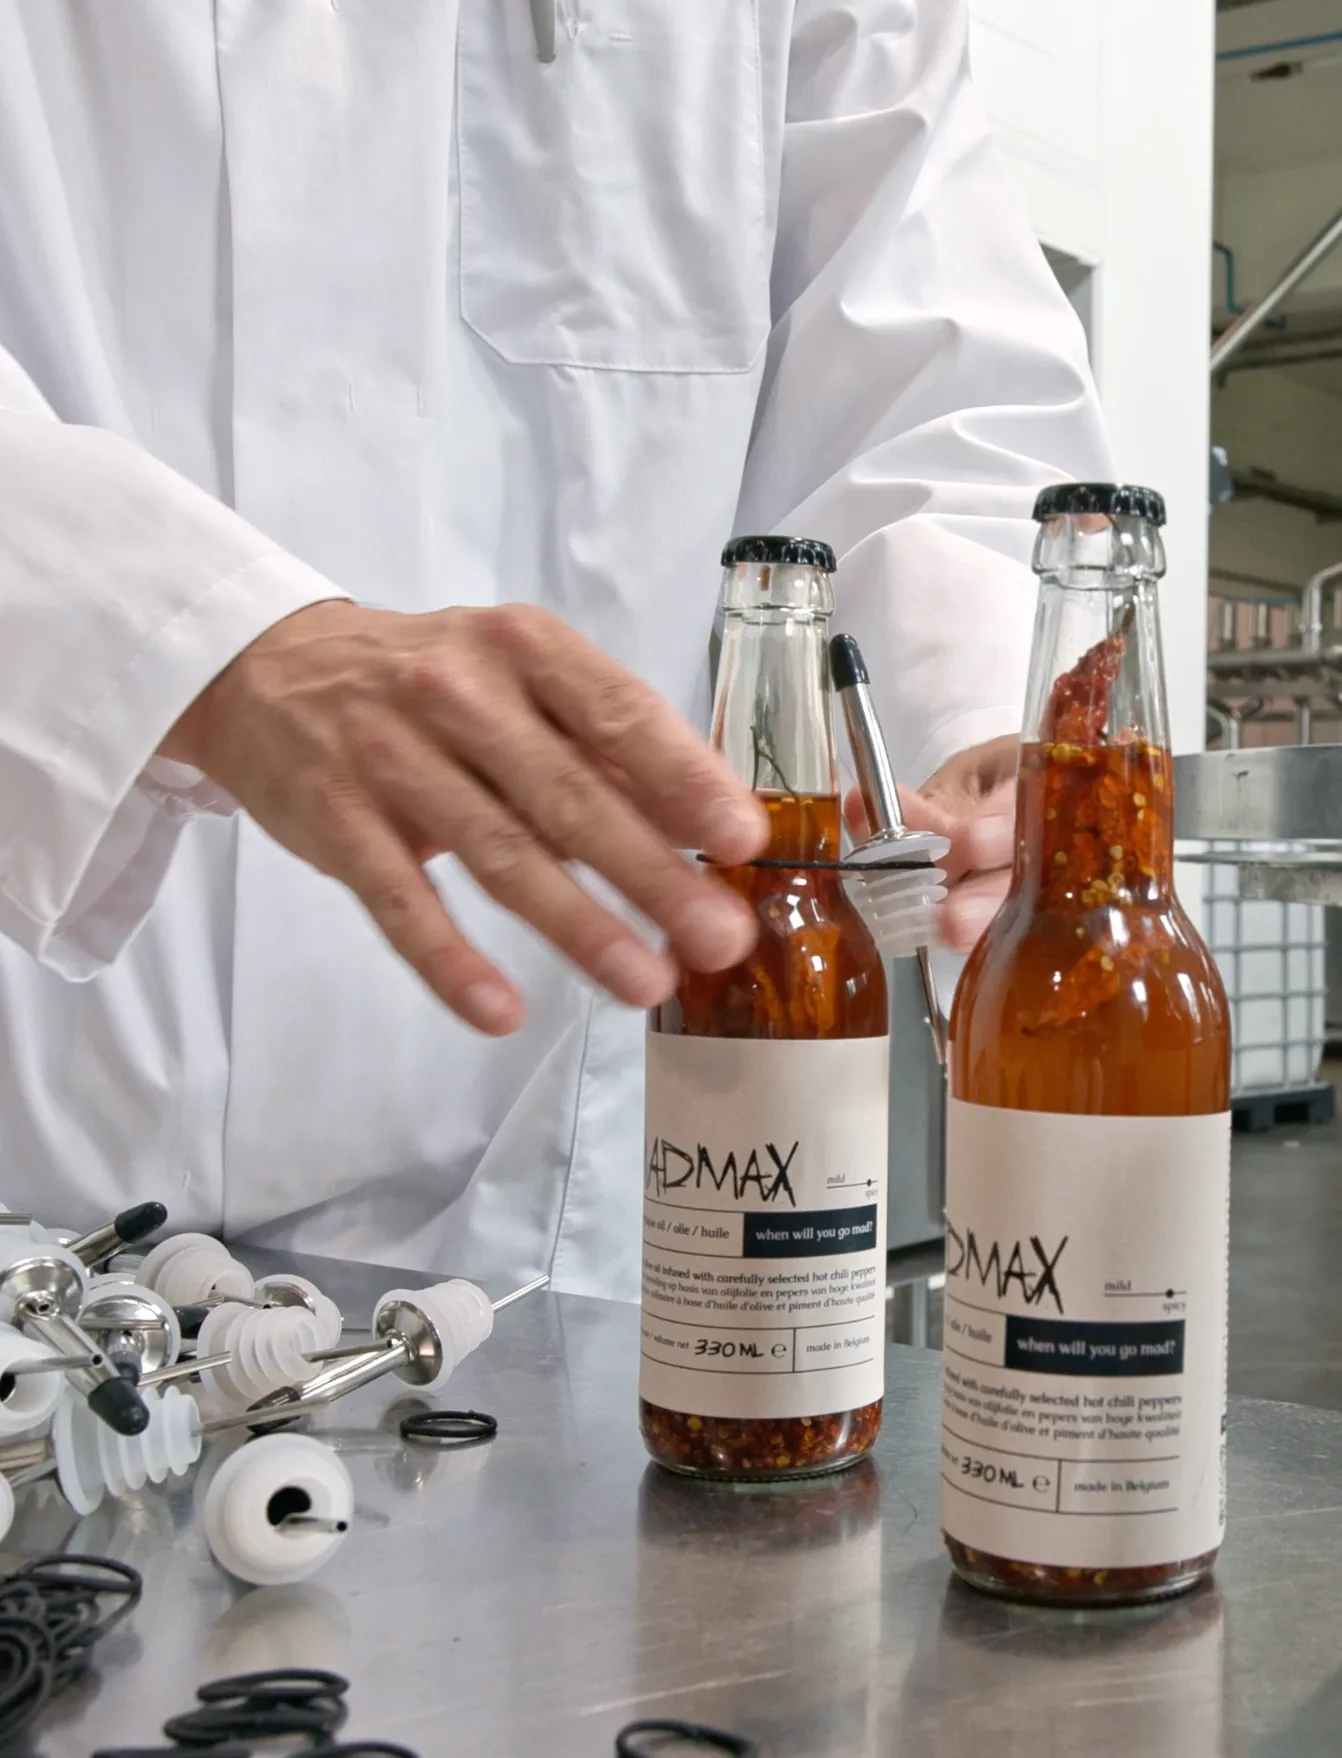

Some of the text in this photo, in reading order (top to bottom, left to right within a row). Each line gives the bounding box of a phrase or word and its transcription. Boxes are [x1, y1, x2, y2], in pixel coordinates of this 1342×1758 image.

[645, 1136, 799, 1208] ADMAX
[826, 1174, 846, 1185] mild
[673, 1223, 690, 1236] olie
[700, 1226, 731, 1239] huile
[755, 1221, 873, 1242] when will you go mad?
[662, 1266, 690, 1279] infused
[692, 1271, 714, 1282] with
[716, 1273, 765, 1286] carefully
[767, 1273, 810, 1284] selected
[812, 1272, 828, 1281] hot
[830, 1269, 849, 1279] chili
[851, 1266, 876, 1280] peppers
[701, 1287, 719, 1297] van
[720, 1287, 758, 1300] olijfolie
[760, 1290, 773, 1298] en
[775, 1288, 809, 1301] pepers
[810, 1287, 827, 1296] van
[829, 1284, 848, 1296] hoge
[1103, 1280, 1132, 1291] mild
[683, 1296, 703, 1307] base
[704, 1299, 738, 1310] d'huile
[740, 1300, 774, 1311] d'olive
[776, 1302, 786, 1311] et
[788, 1300, 821, 1313] piment
[823, 1297, 853, 1308] d'haute
[1162, 1301, 1187, 1315] spicy
[967, 1323, 993, 1344] huile
[676, 1341, 690, 1350] net
[806, 1336, 870, 1353] made in Belgium
[1016, 1335, 1177, 1361] when will you go mad?
[980, 1384, 1026, 1405] carefully
[1029, 1392, 1079, 1406] selected
[1083, 1394, 1105, 1408] hot
[1107, 1394, 1135, 1407] chili
[1138, 1395, 1183, 1411] peppers
[1021, 1409, 1036, 1420] en
[1038, 1411, 1078, 1426] pepers
[1081, 1414, 1103, 1424] van
[1105, 1411, 1134, 1427] hoge
[1038, 1427, 1050, 1437] et
[1053, 1429, 1094, 1442] piment
[1074, 1479, 1171, 1495] made in Belgium
